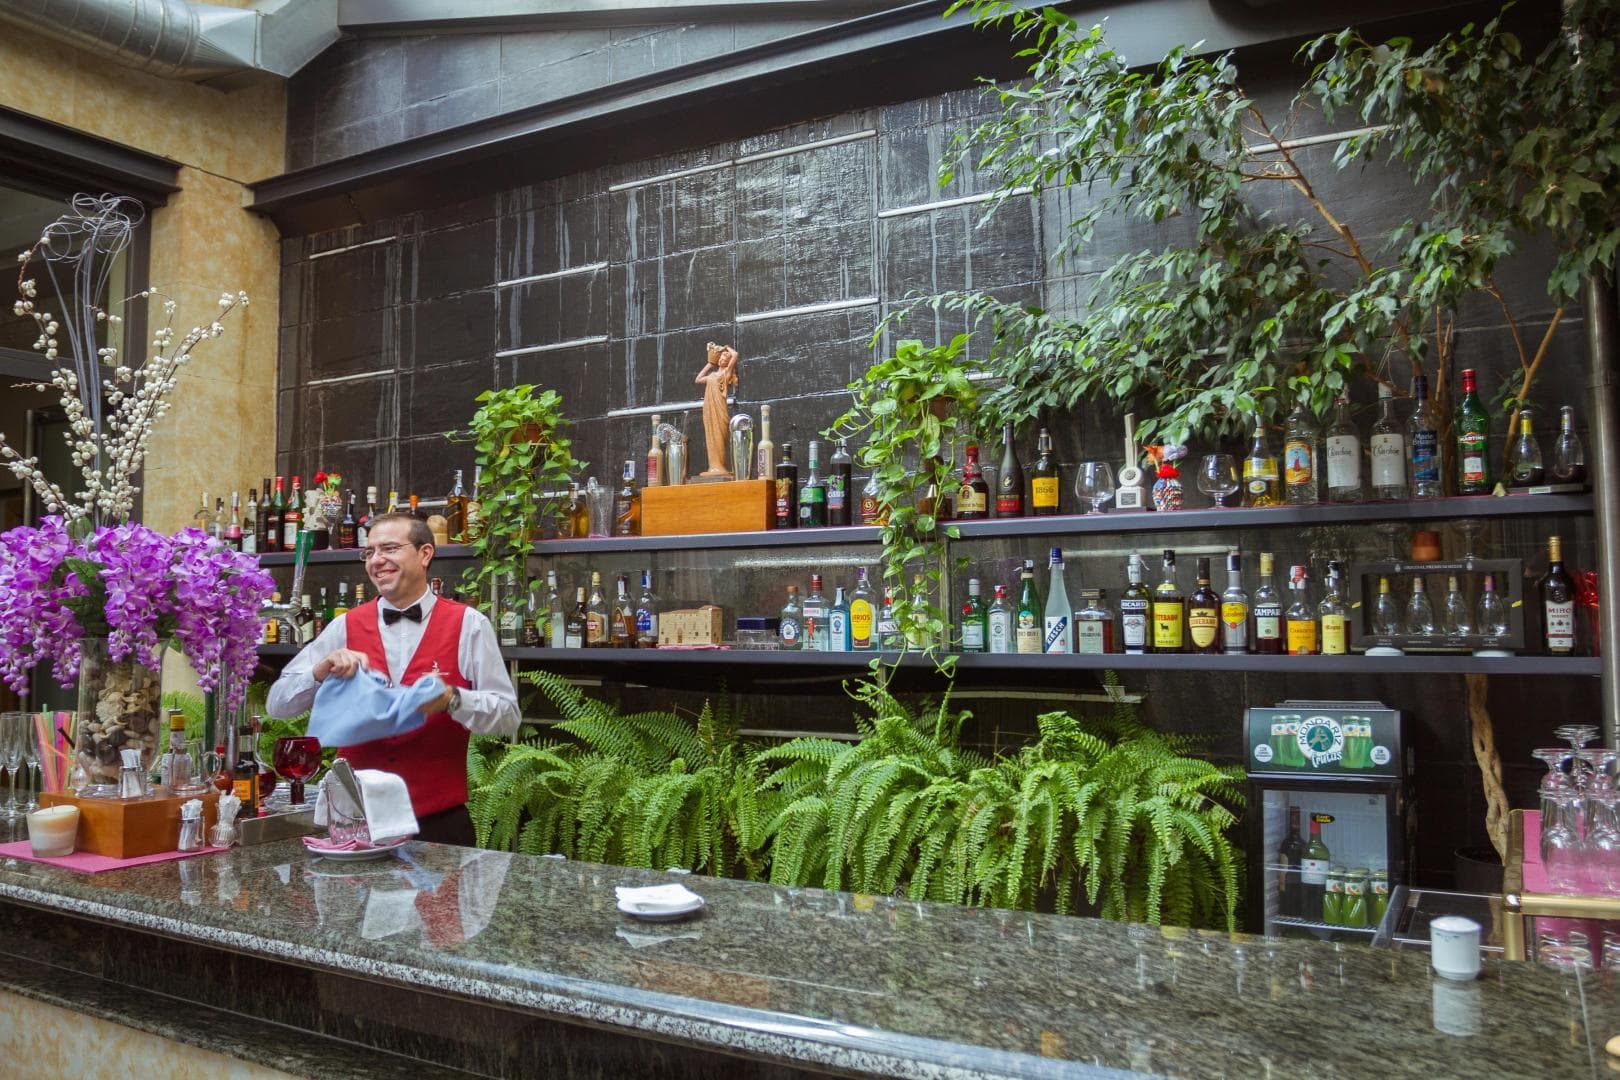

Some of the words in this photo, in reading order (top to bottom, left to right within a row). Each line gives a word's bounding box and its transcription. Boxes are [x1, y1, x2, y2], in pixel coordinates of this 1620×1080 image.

[1254, 608, 1280, 616] CAMPAR
[1299, 718, 1342, 746] MONDARIZ
[1311, 750, 1343, 769] frutas
